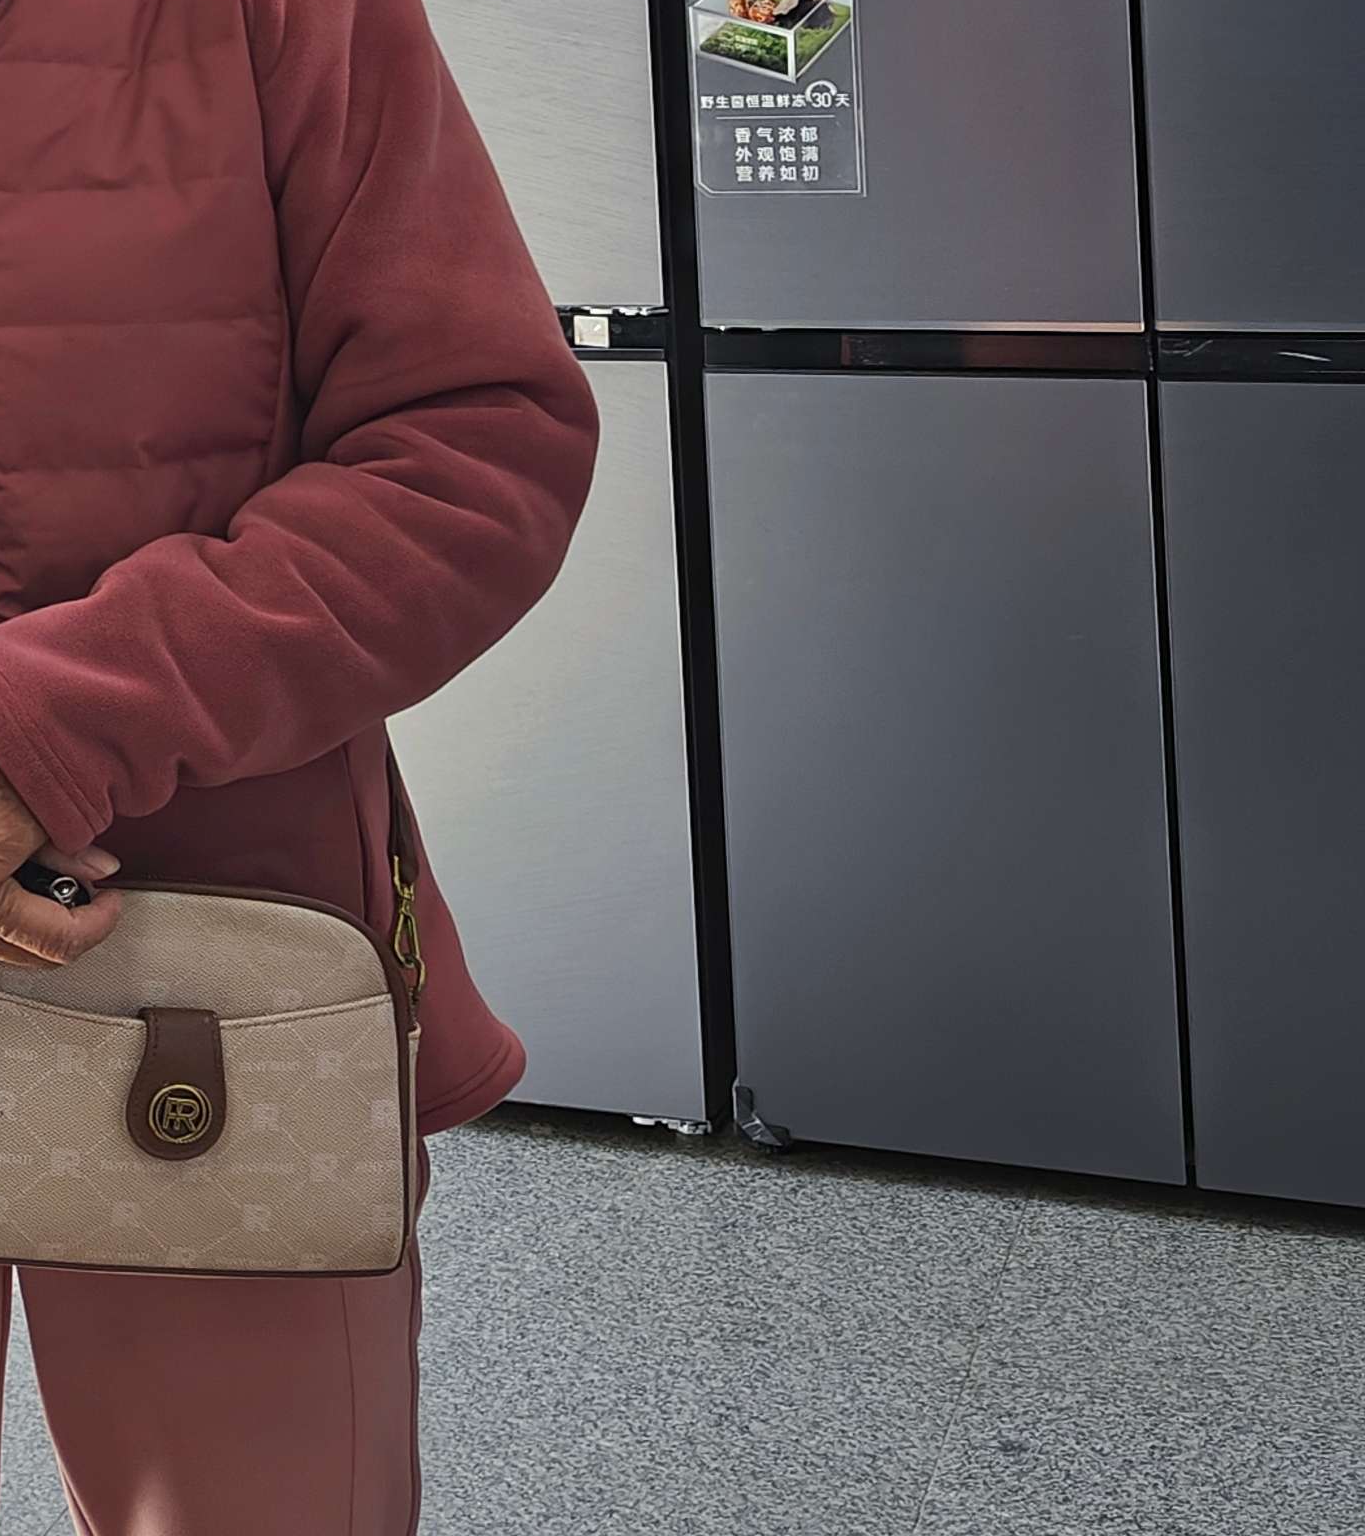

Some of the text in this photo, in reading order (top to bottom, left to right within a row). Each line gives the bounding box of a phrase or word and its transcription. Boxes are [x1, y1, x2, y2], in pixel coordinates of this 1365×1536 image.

[734, 127, 819, 144] 香气浓郁
[735, 145, 819, 163] 外观饱满
[735, 165, 819, 183] 营养如初
